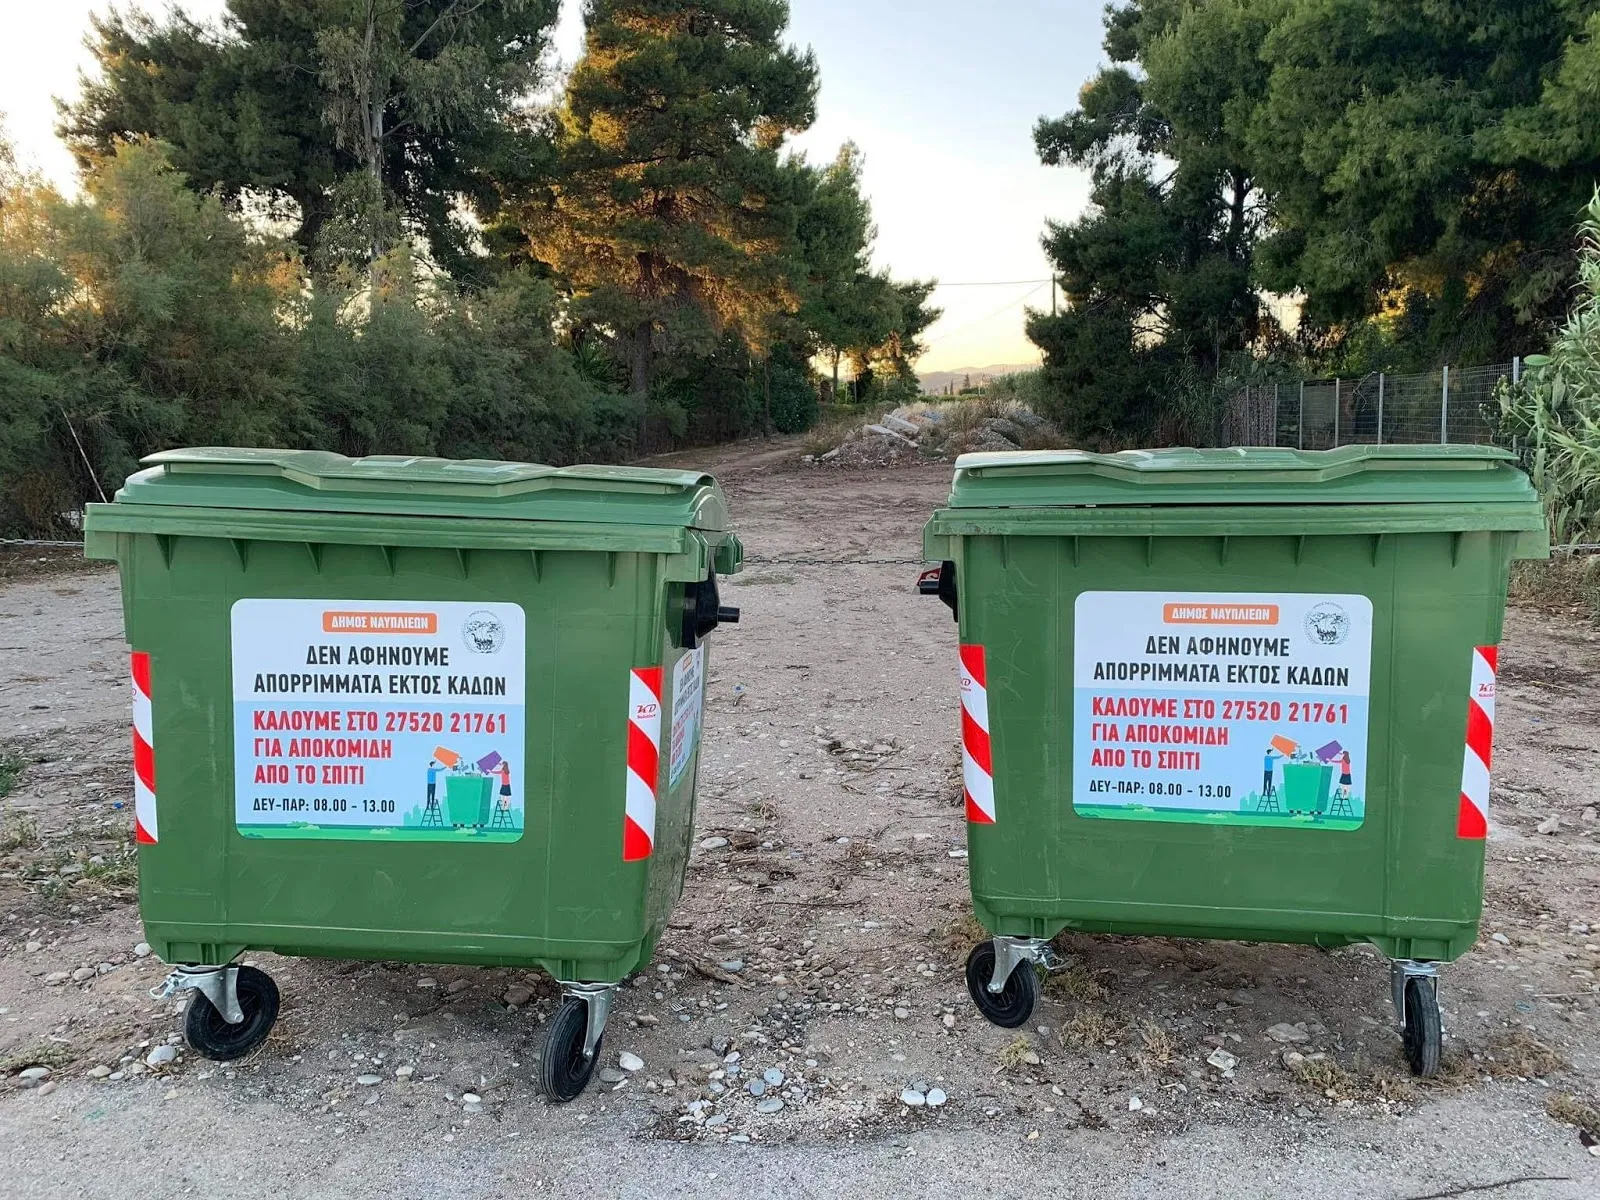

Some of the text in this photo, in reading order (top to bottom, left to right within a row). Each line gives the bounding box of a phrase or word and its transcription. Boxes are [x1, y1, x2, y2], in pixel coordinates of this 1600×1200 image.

[331, 616, 428, 629] ΔΗΜΟΣ ΝΑΥΠΛΙΕΩΝ
[1172, 607, 1270, 621] ΔΗΜΟΣ ΝΑΥΠΛΙΕΩΝ
[306, 645, 449, 666] ΔΕΝ ΑΦΗΝΟΥΜΕ
[1145, 635, 1290, 657] ΔΕΝ ΑΦΗΝΟΥΜΕ
[254, 673, 506, 696] ΑΠΟΡΡΙΜΜΑΤΑ ΕΚΤΟΣ ΚΑΔΩΝ
[1093, 662, 1349, 687] ΑΠΟΡΡΙΜΜΑΤΑ ΕΚΤΟΣ ΚΑΔΩΝ
[1092, 696, 1348, 724] ΚΑΛΟΥΜΕ ΣΤΟ 27520 21761
[253, 710, 506, 734] ΚΑΛΟΥΜΕ ΣΤΟ 27520 21761
[1092, 723, 1228, 746] ΓΙΑ ΑΠΟΚΟΜΙΔΗ
[254, 738, 392, 759] ΓΙΑ ΑΠΟΚΟΜΙΔΗ
[1091, 748, 1201, 771] ΑΠΟ ΤΟ ΣΠΙΤΙ
[254, 764, 364, 785] ΑΠΟ ΤΟ ΣΠΙΤΙ
[1089, 780, 1145, 795] ΔΕΥ-ΠΑΡ:
[1148, 782, 1182, 796] 08.00
[1198, 784, 1232, 798] 13.00
[253, 797, 309, 812] ΔΕΥ-ΠΑΡ:
[313, 798, 347, 812] 08.00
[362, 799, 395, 813] 13.00
